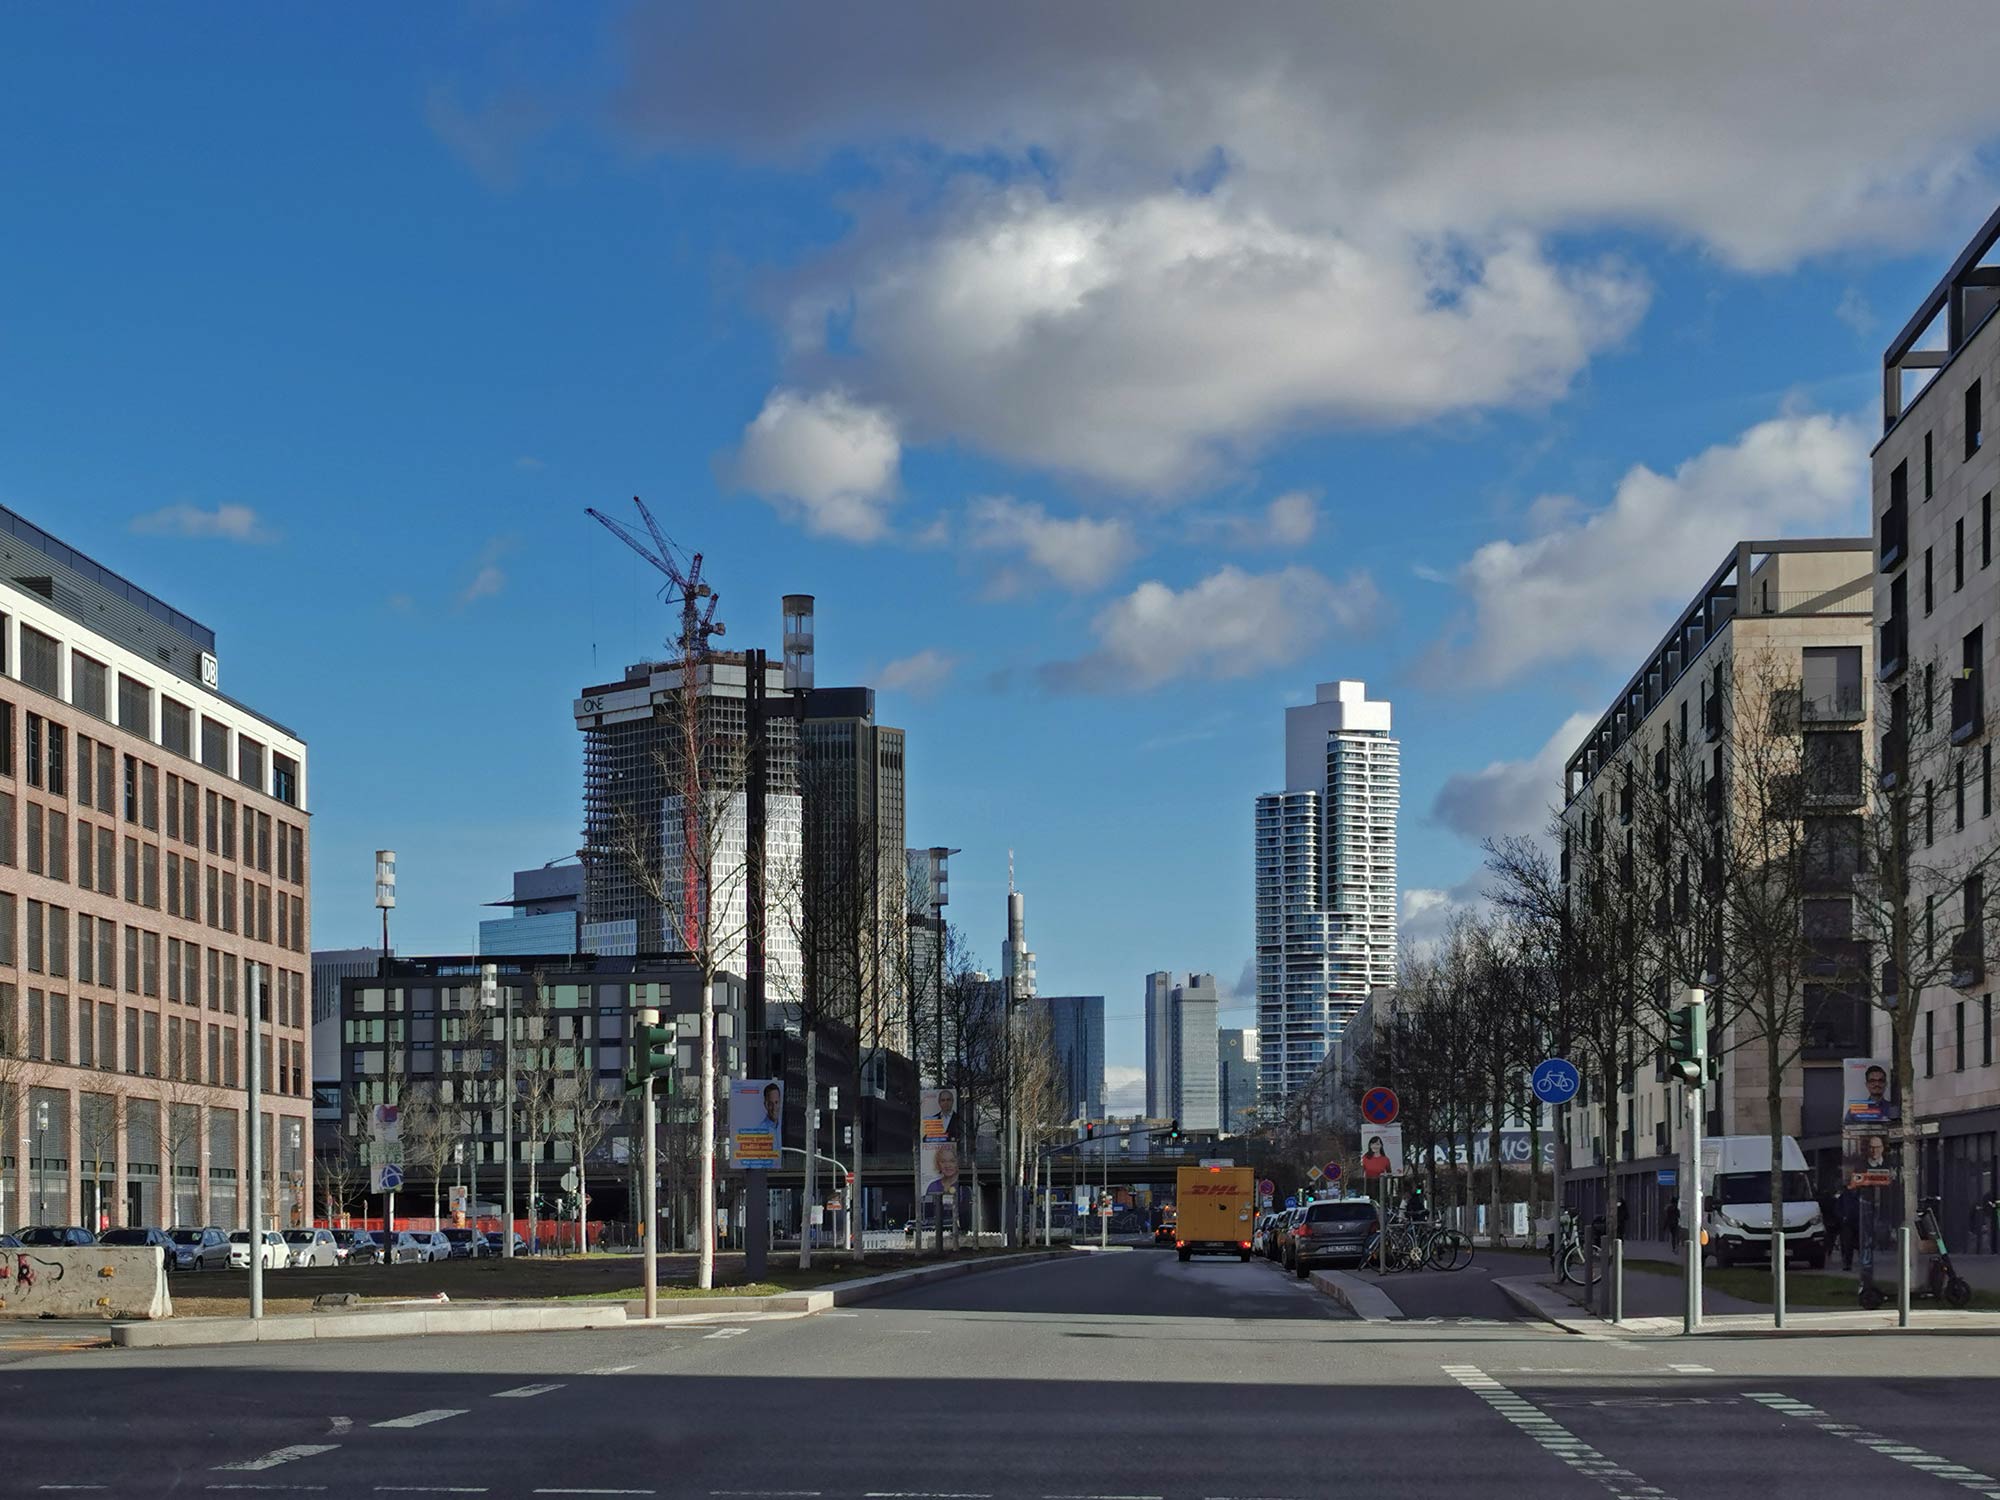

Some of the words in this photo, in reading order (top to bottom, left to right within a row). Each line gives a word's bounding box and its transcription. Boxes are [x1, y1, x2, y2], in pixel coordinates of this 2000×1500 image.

[203, 658, 217, 685] DB
[583, 697, 604, 713] ONE
[1191, 1184, 1240, 1196] DHL
